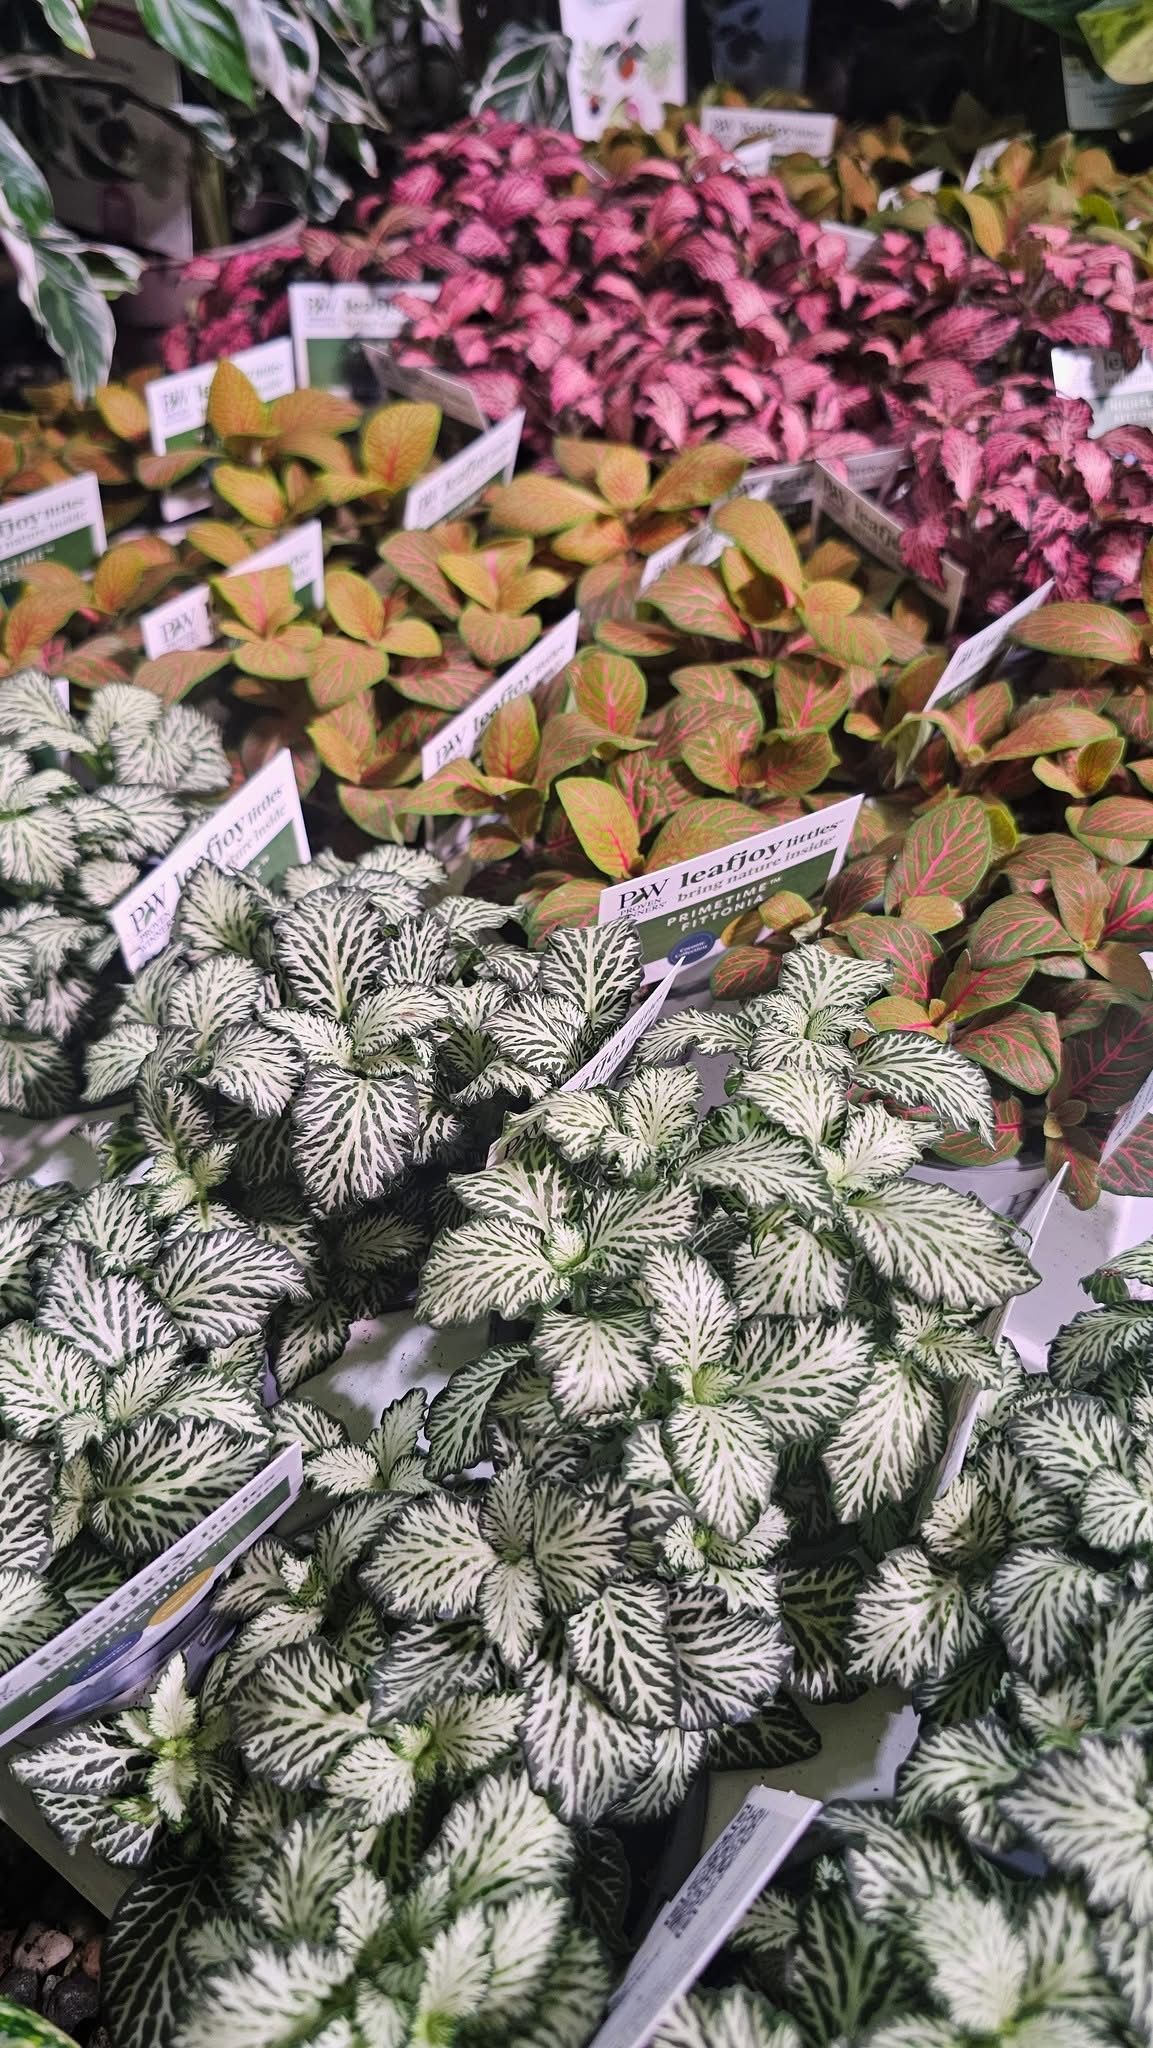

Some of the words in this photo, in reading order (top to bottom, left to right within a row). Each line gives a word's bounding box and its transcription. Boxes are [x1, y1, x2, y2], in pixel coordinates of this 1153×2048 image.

[617, 877, 671, 911] PW
[680, 839, 784, 890] leafjoy
[677, 880, 723, 903] bring
[726, 857, 781, 886] nature
[129, 882, 166, 934] PW
[620, 898, 662, 916] PROVEN
[681, 895, 764, 932] FITTONIA
